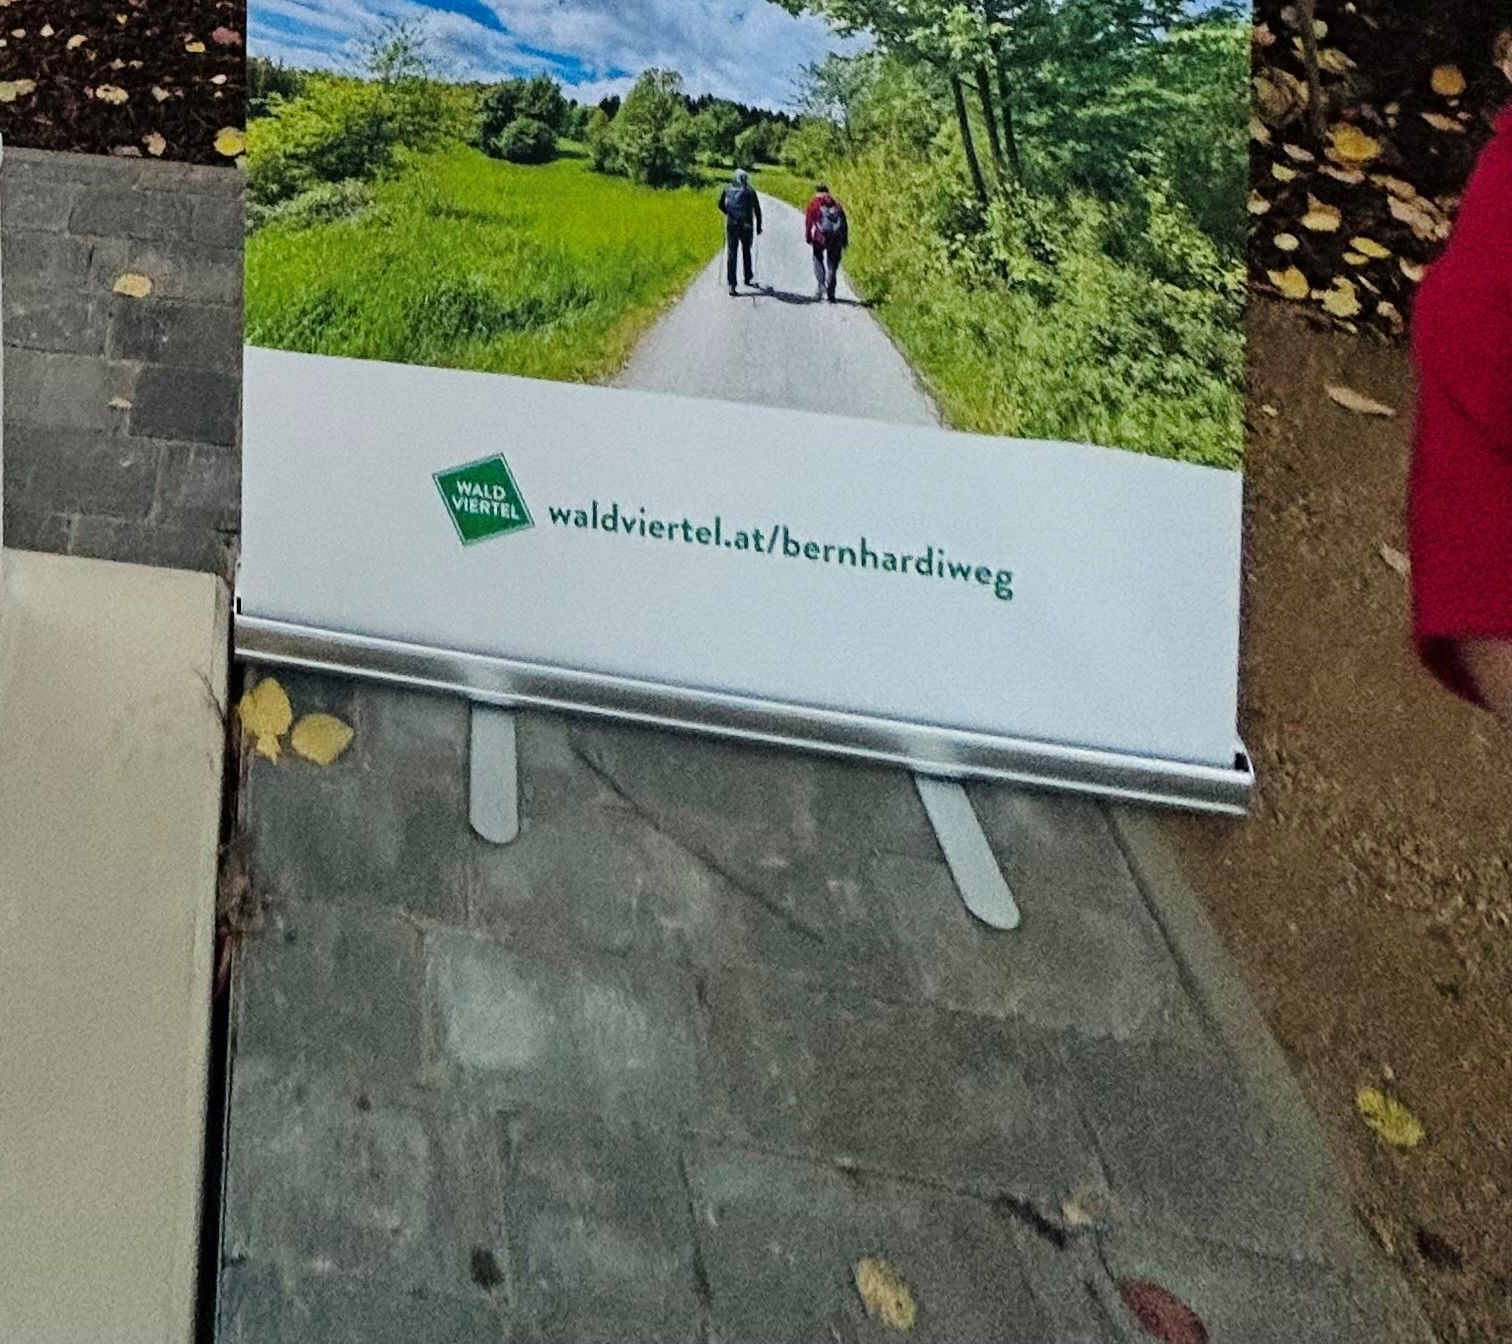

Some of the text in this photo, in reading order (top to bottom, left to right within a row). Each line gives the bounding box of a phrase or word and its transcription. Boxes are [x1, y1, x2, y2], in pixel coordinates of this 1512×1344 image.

[457, 479, 506, 502] WALD
[451, 494, 520, 521] VIERTEL
[547, 500, 1014, 601] waldviertel.at/bernhardiweg
